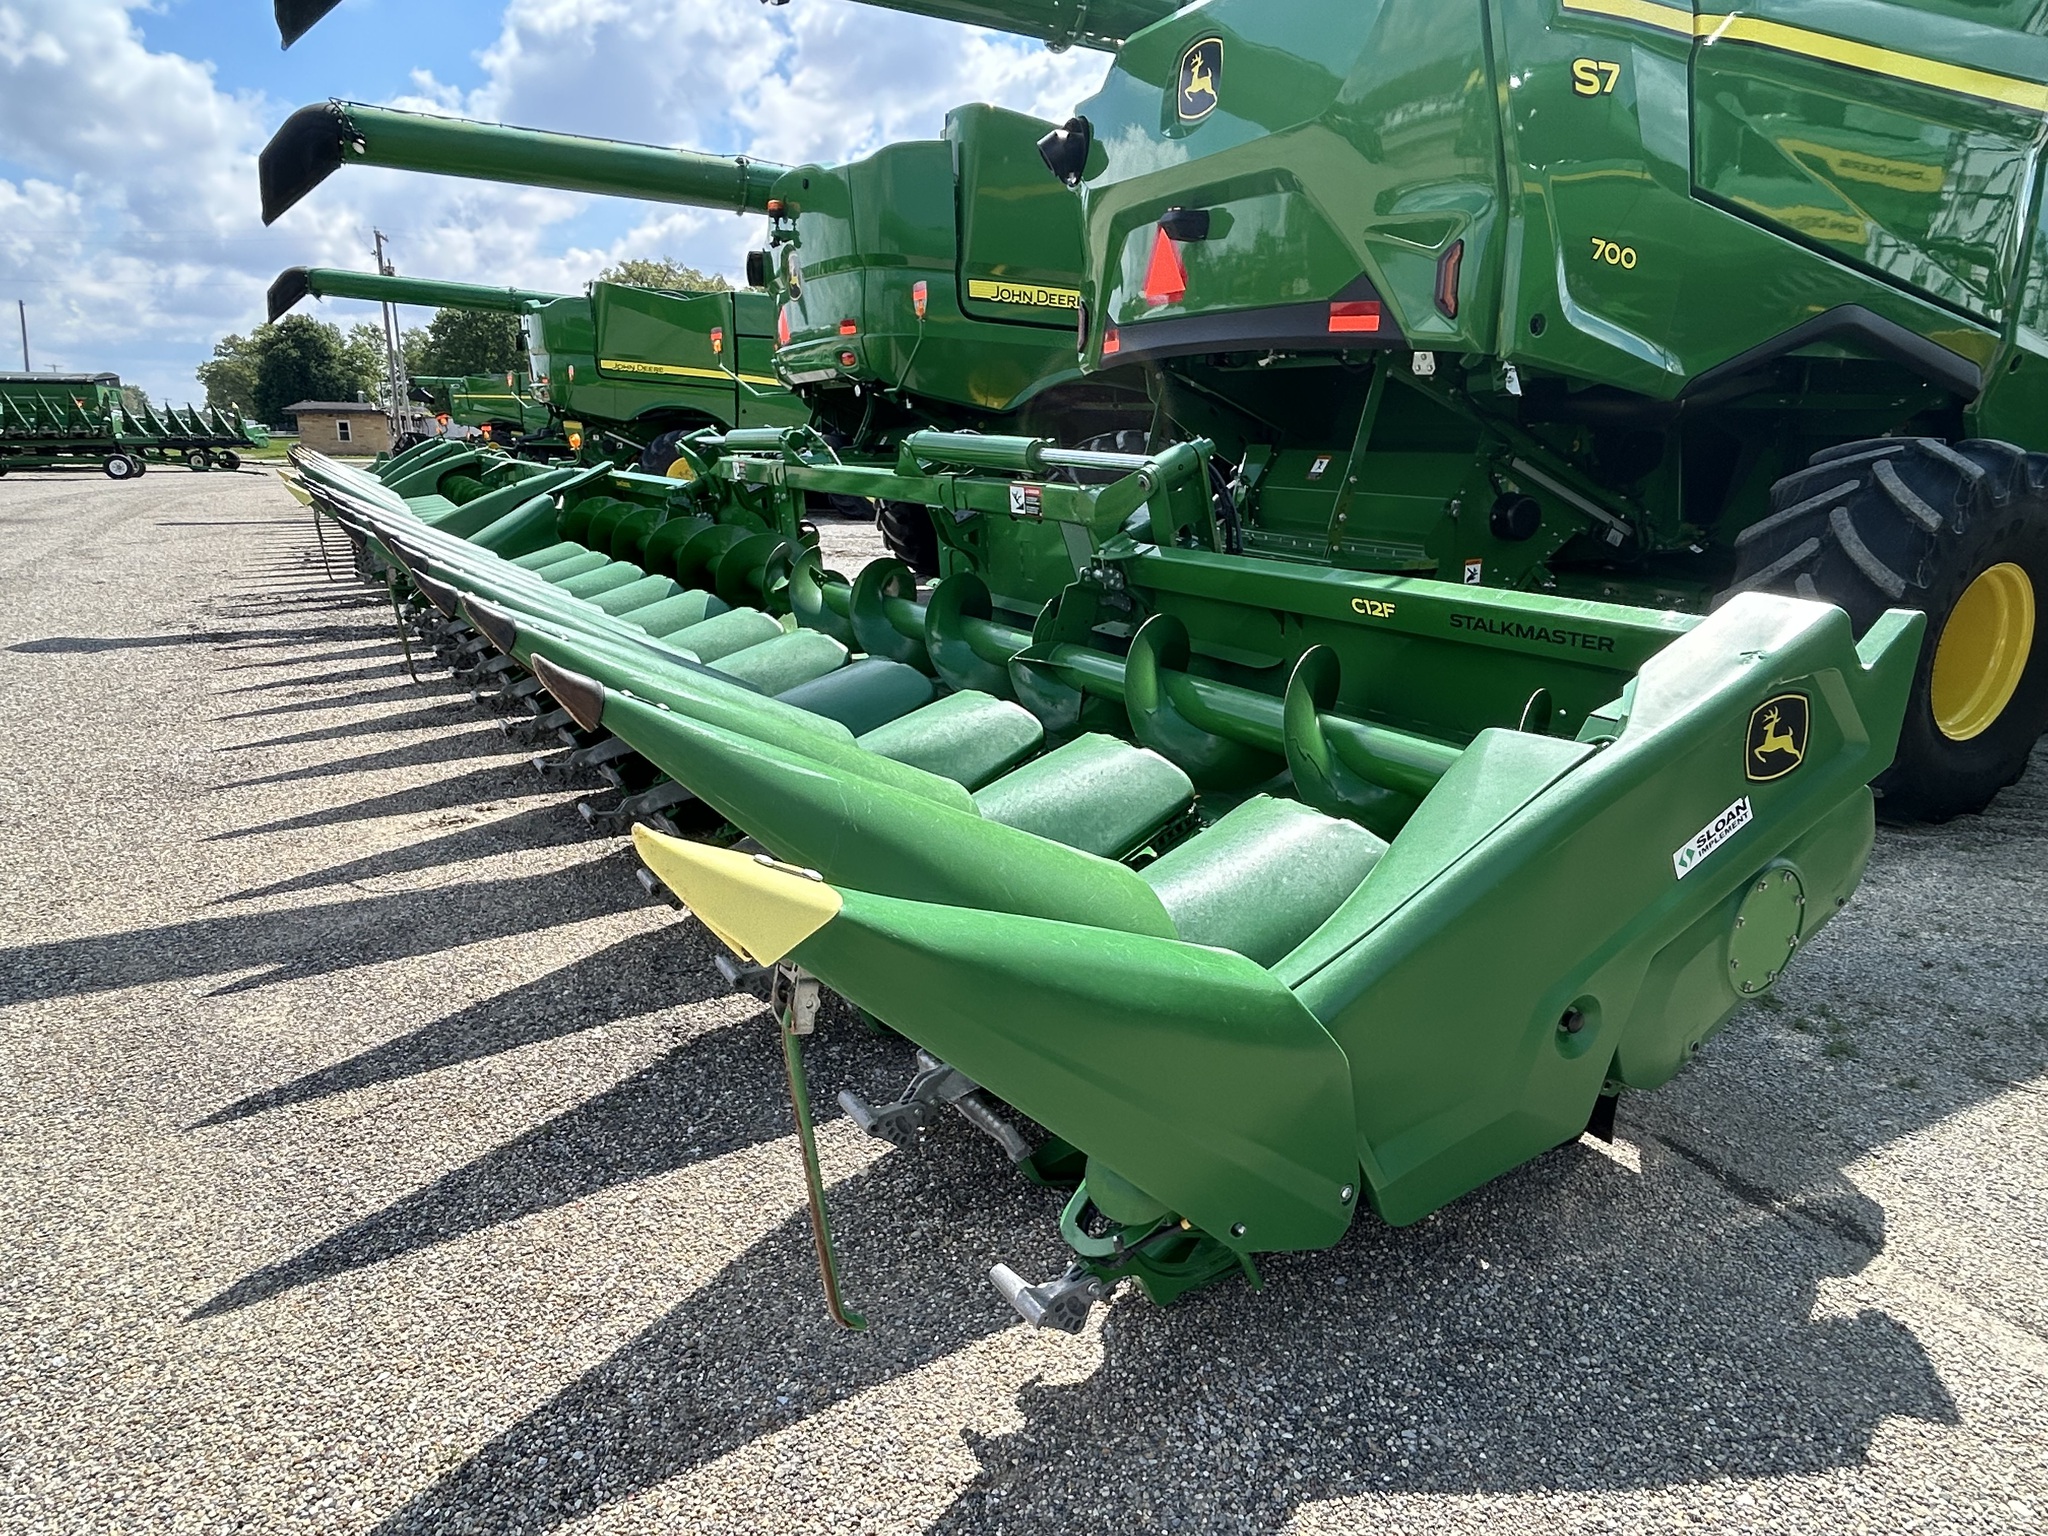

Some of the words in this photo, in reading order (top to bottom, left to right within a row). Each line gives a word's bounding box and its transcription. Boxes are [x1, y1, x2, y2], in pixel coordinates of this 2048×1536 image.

[1571, 58, 1621, 96] S7
[1590, 237, 1637, 270] 700
[991, 285, 1033, 302] JOHN
[612, 362, 635, 372] JOHN
[636, 364, 664, 373] DEERE
[1351, 597, 1396, 619] C12F
[1449, 612, 1615, 653] STALKMASTER
[1696, 797, 1747, 849] SLOAN
[1698, 811, 1749, 857] IMPLEMENT
